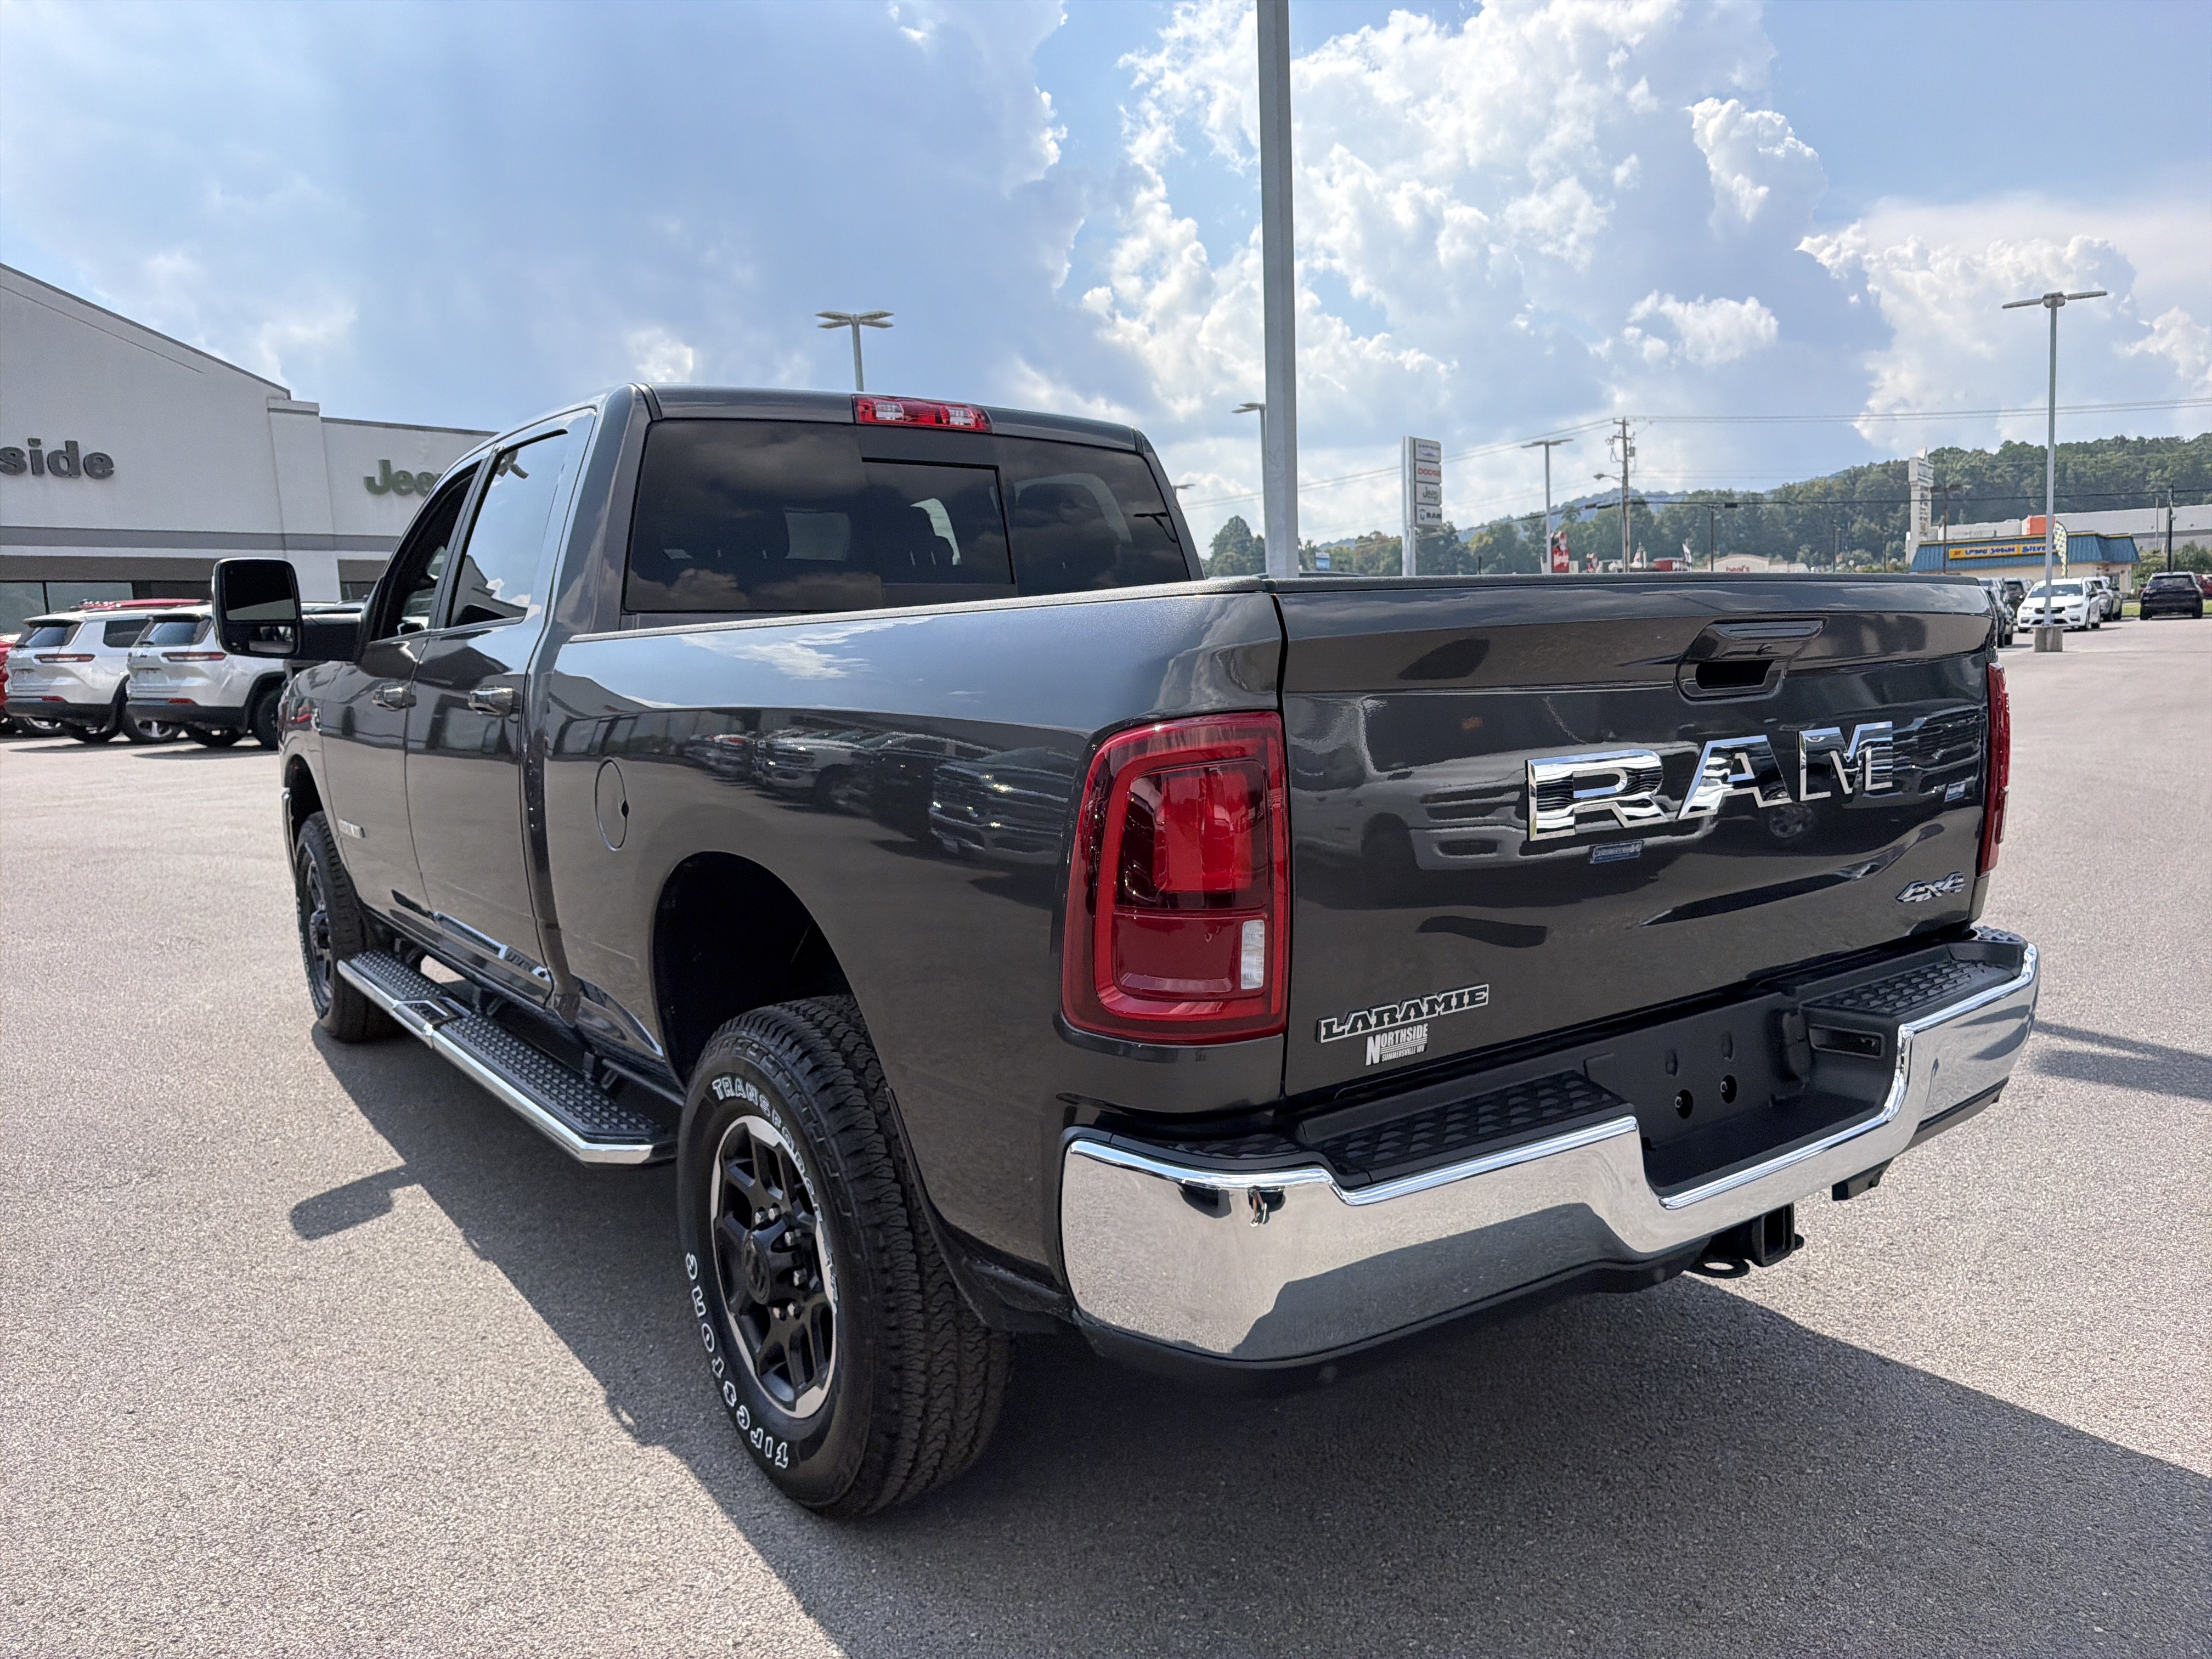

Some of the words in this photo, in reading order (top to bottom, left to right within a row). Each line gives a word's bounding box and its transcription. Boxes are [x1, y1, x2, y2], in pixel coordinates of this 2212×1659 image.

[0, 438, 115, 479] side
[363, 459, 443, 496] Jee
[1418, 468, 1441, 478] DODGE
[1423, 487, 1438, 500] Jeep
[1526, 721, 1893, 842] RAM
[1317, 984, 1489, 1043] LARAMIE
[1365, 1023, 1429, 1066] NORTHSIDE
[1381, 1046, 1416, 1062] SUMMERSVILLE
[1417, 1043, 1425, 1053] WV
